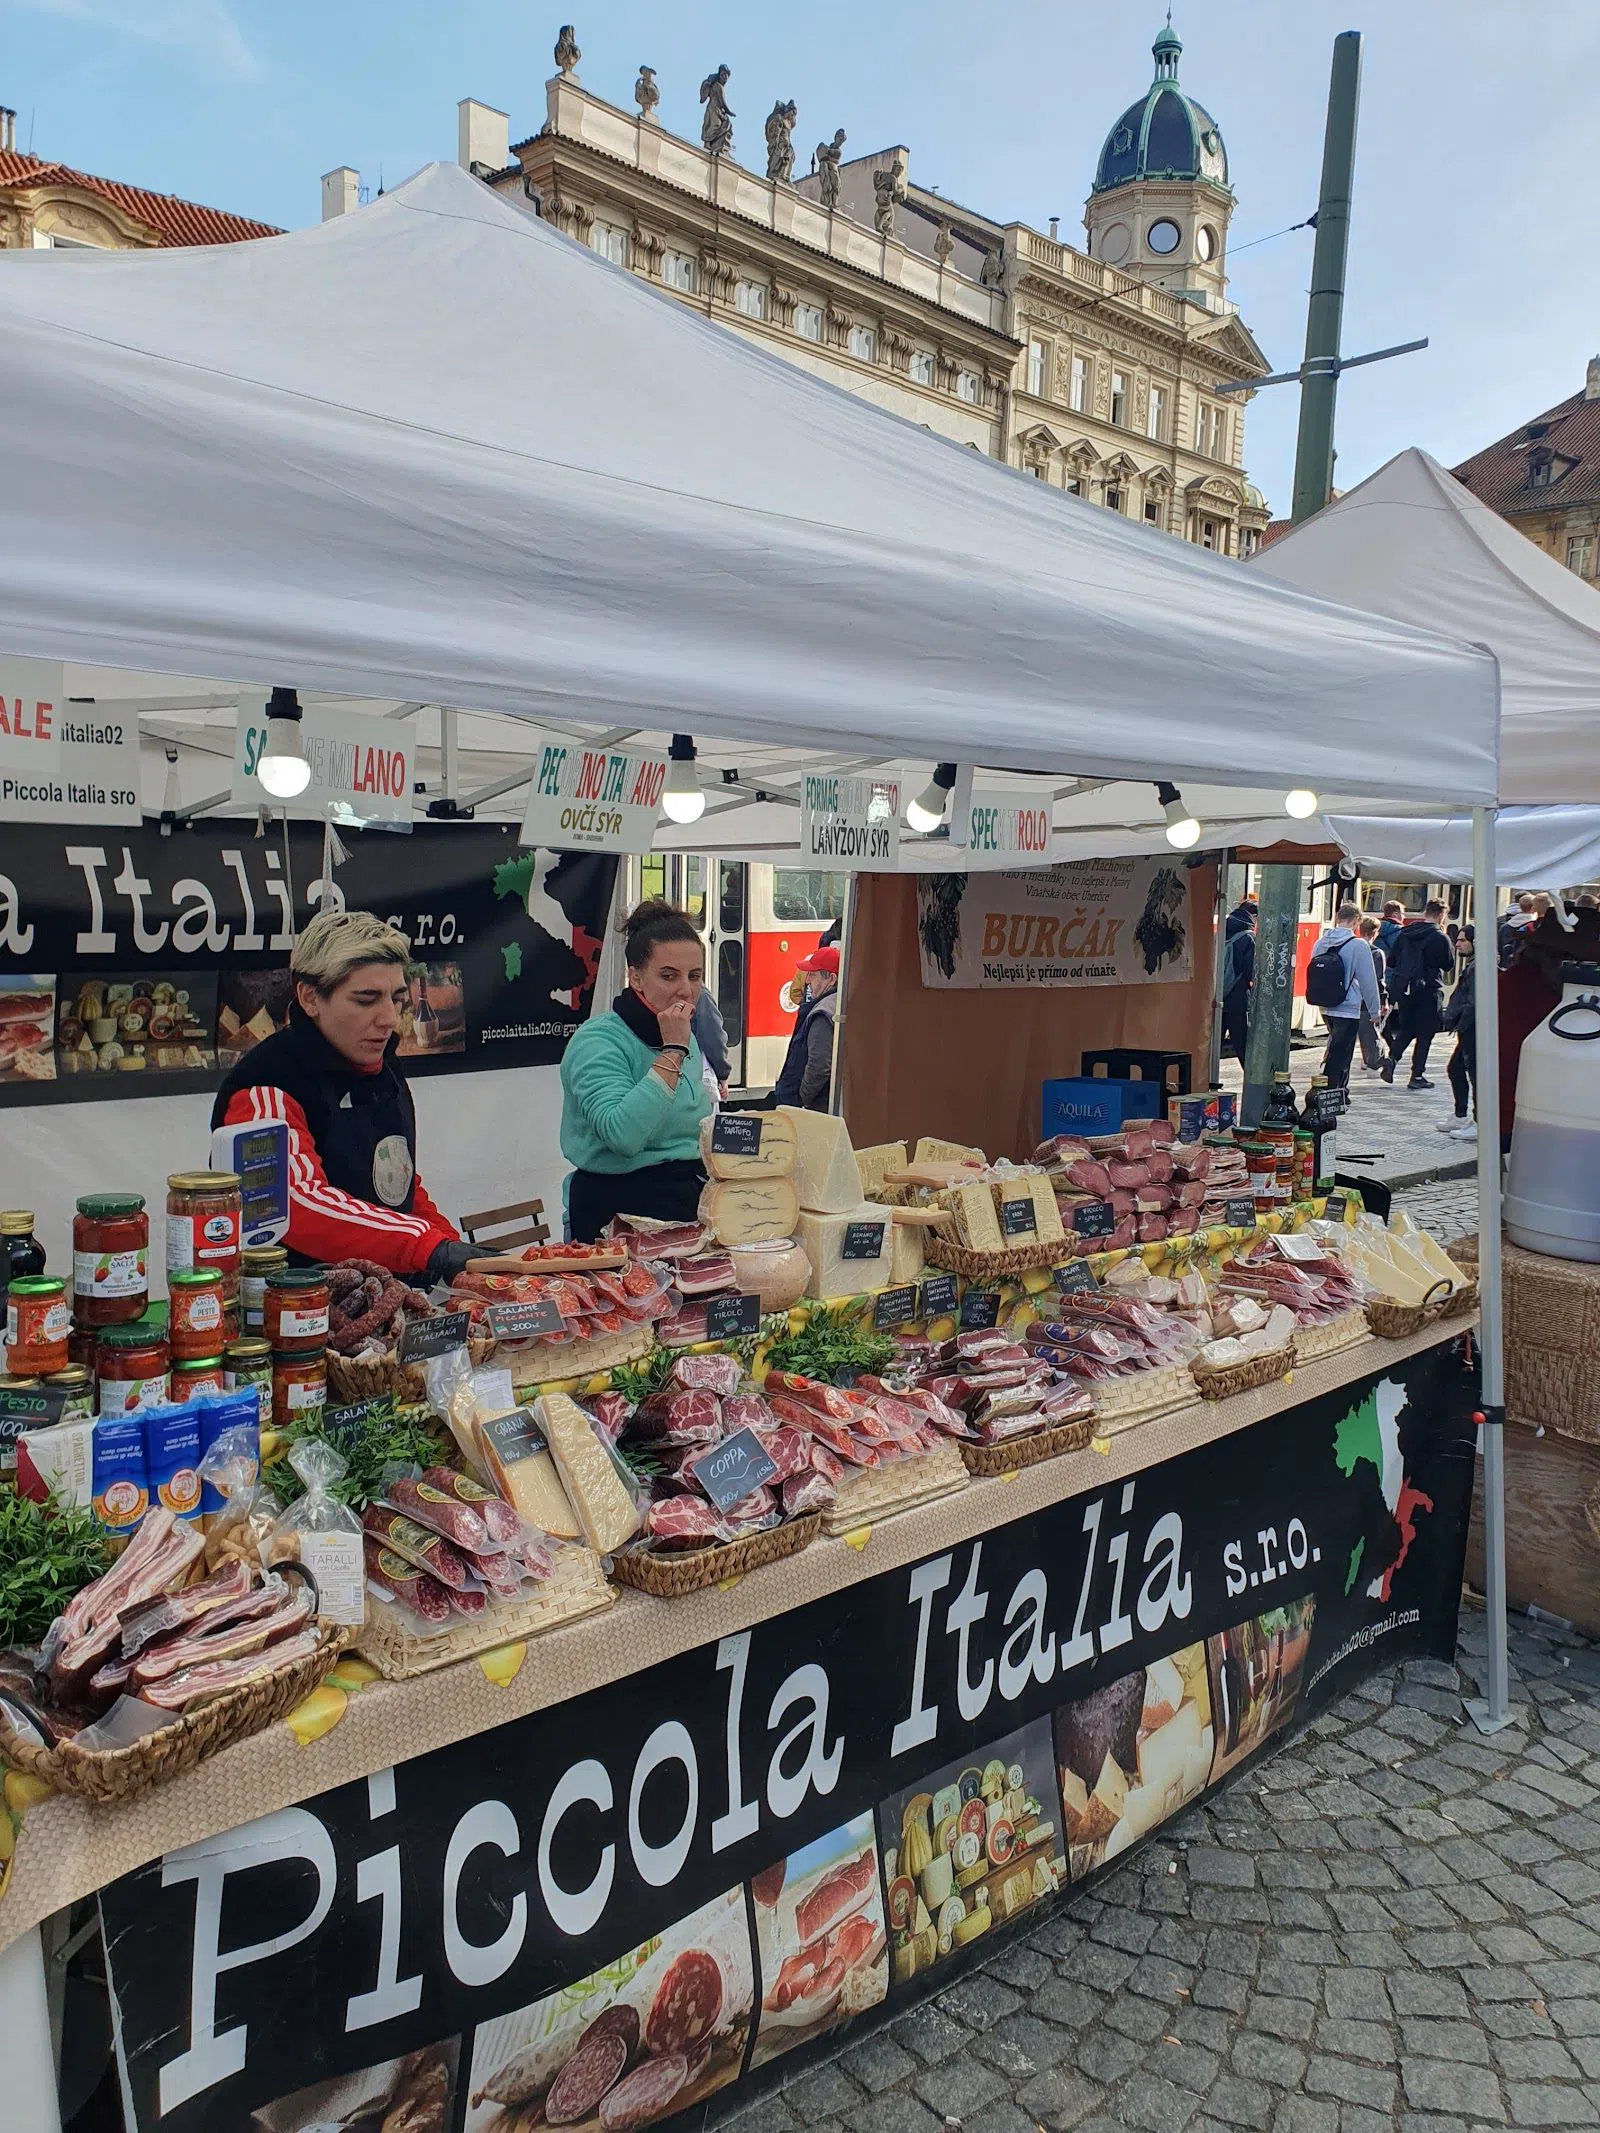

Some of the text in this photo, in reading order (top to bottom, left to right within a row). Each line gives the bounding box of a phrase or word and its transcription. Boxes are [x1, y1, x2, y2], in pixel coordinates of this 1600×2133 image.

[61, 722, 123, 745] italia02
[327, 741, 405, 798] MILANO
[537, 747, 666, 808] PECORINO ITALIANO
[3, 779, 136, 805] Piccola Italia sro
[560, 804, 623, 835] OVČÍ SÝR
[982, 906, 1126, 959] BURČÁK
[983, 963, 1025, 982] Nejlepší
[1026, 964, 1037, 982] je
[1037, 964, 1068, 981] přímo
[1070, 964, 1084, 978] od
[1057, 1102, 1103, 1119] AQUILA
[497, 1303, 540, 1316] SALAME
[714, 1308, 744, 1320] TIROLO
[717, 1298, 743, 1310] SPECK
[410, 1313, 467, 1337] SALSICCIA
[495, 1311, 549, 1323] PICCANTE
[412, 1327, 458, 1346] ITALIANA
[494, 1416, 528, 1437] GRANA
[709, 1446, 747, 1479] COPPA
[310, 1553, 357, 1565] TARALLI
[158, 1481, 1322, 2118] Piccola Italia s.r.o.
